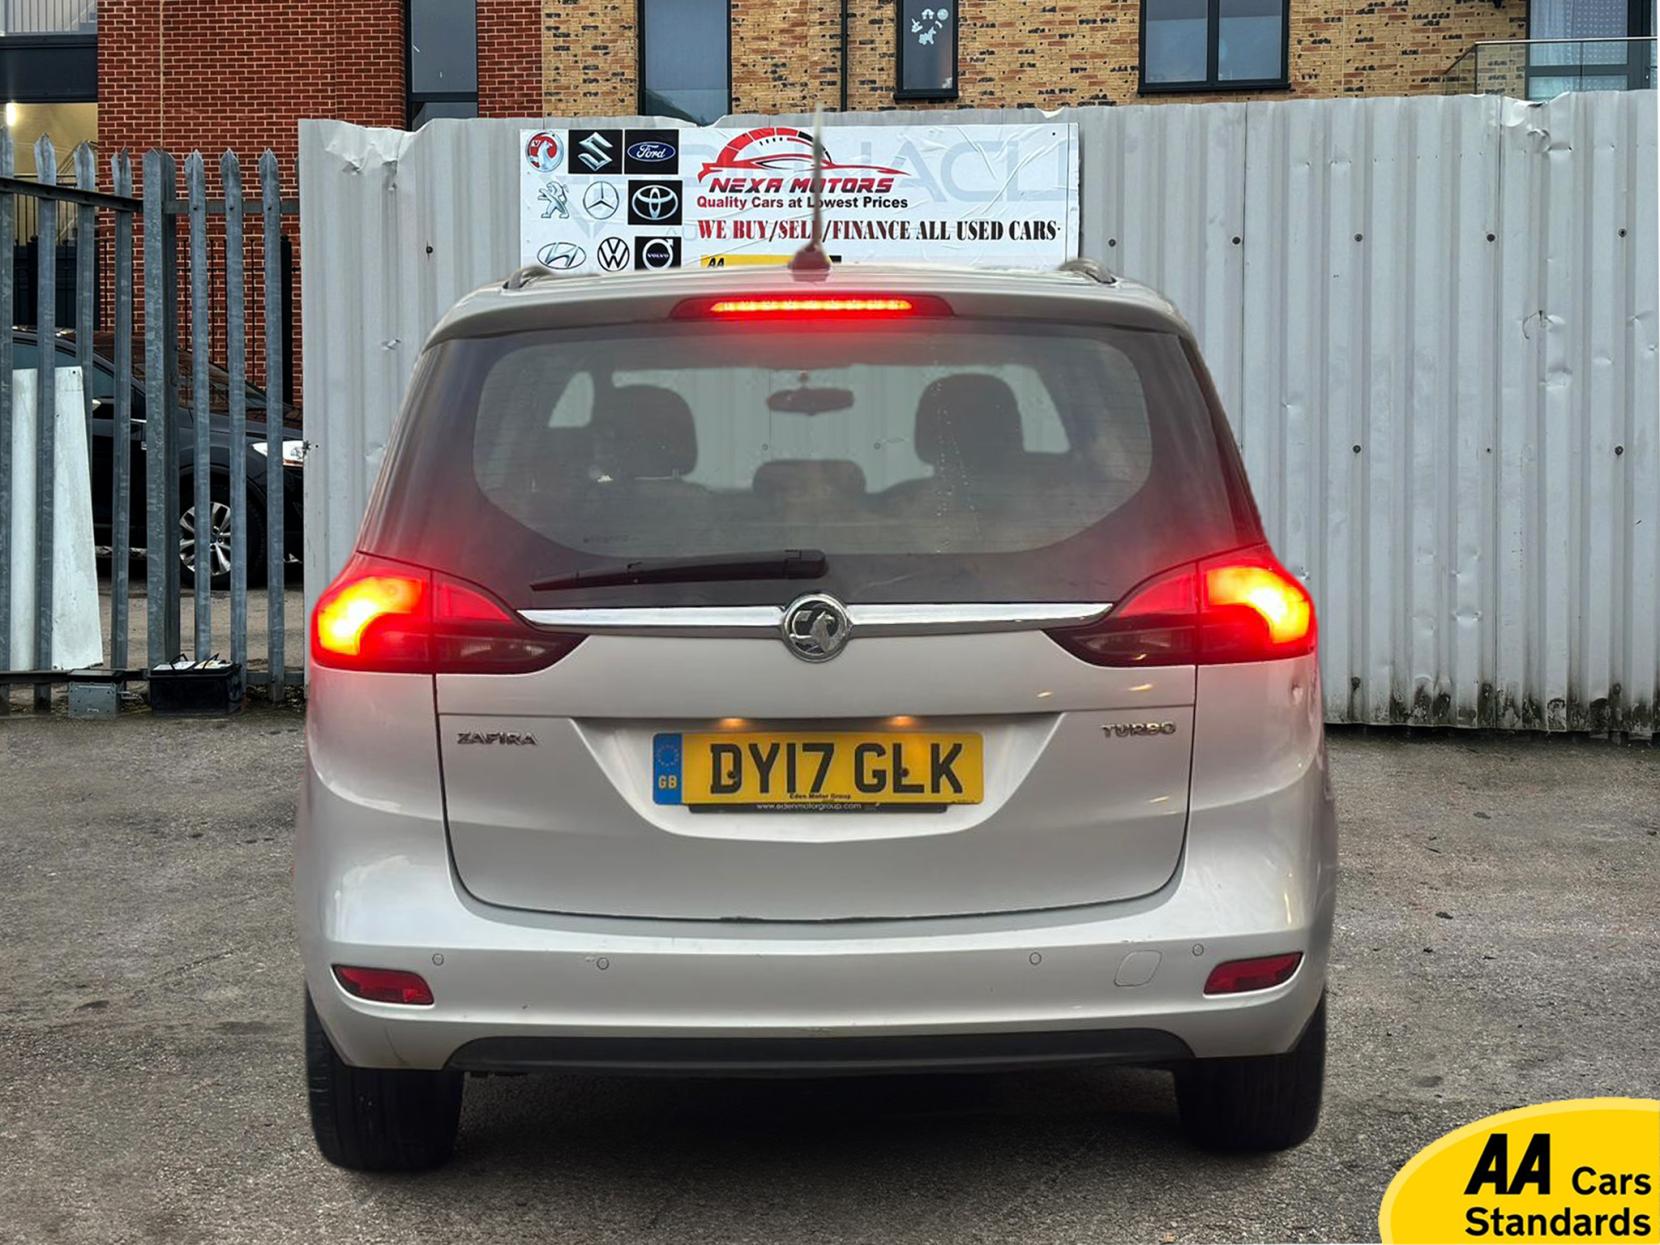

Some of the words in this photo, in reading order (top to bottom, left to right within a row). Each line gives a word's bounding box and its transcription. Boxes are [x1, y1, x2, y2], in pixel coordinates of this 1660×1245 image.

[636, 144, 665, 158] Ford
[709, 178, 784, 193] NEXA
[697, 195, 747, 210] Quality
[752, 196, 784, 208] Cars
[788, 197, 802, 208] at
[863, 196, 908, 208] Prices
[697, 220, 726, 239] WE
[916, 220, 950, 240] ALL
[956, 220, 1004, 240] USED
[1008, 220, 1057, 240] CARS
[1102, 722, 1176, 738] TURBO
[457, 732, 537, 746] ZAFIRA
[710, 743, 835, 794] DY17
[854, 743, 963, 794] GLK
[658, 775, 677, 789] GB
